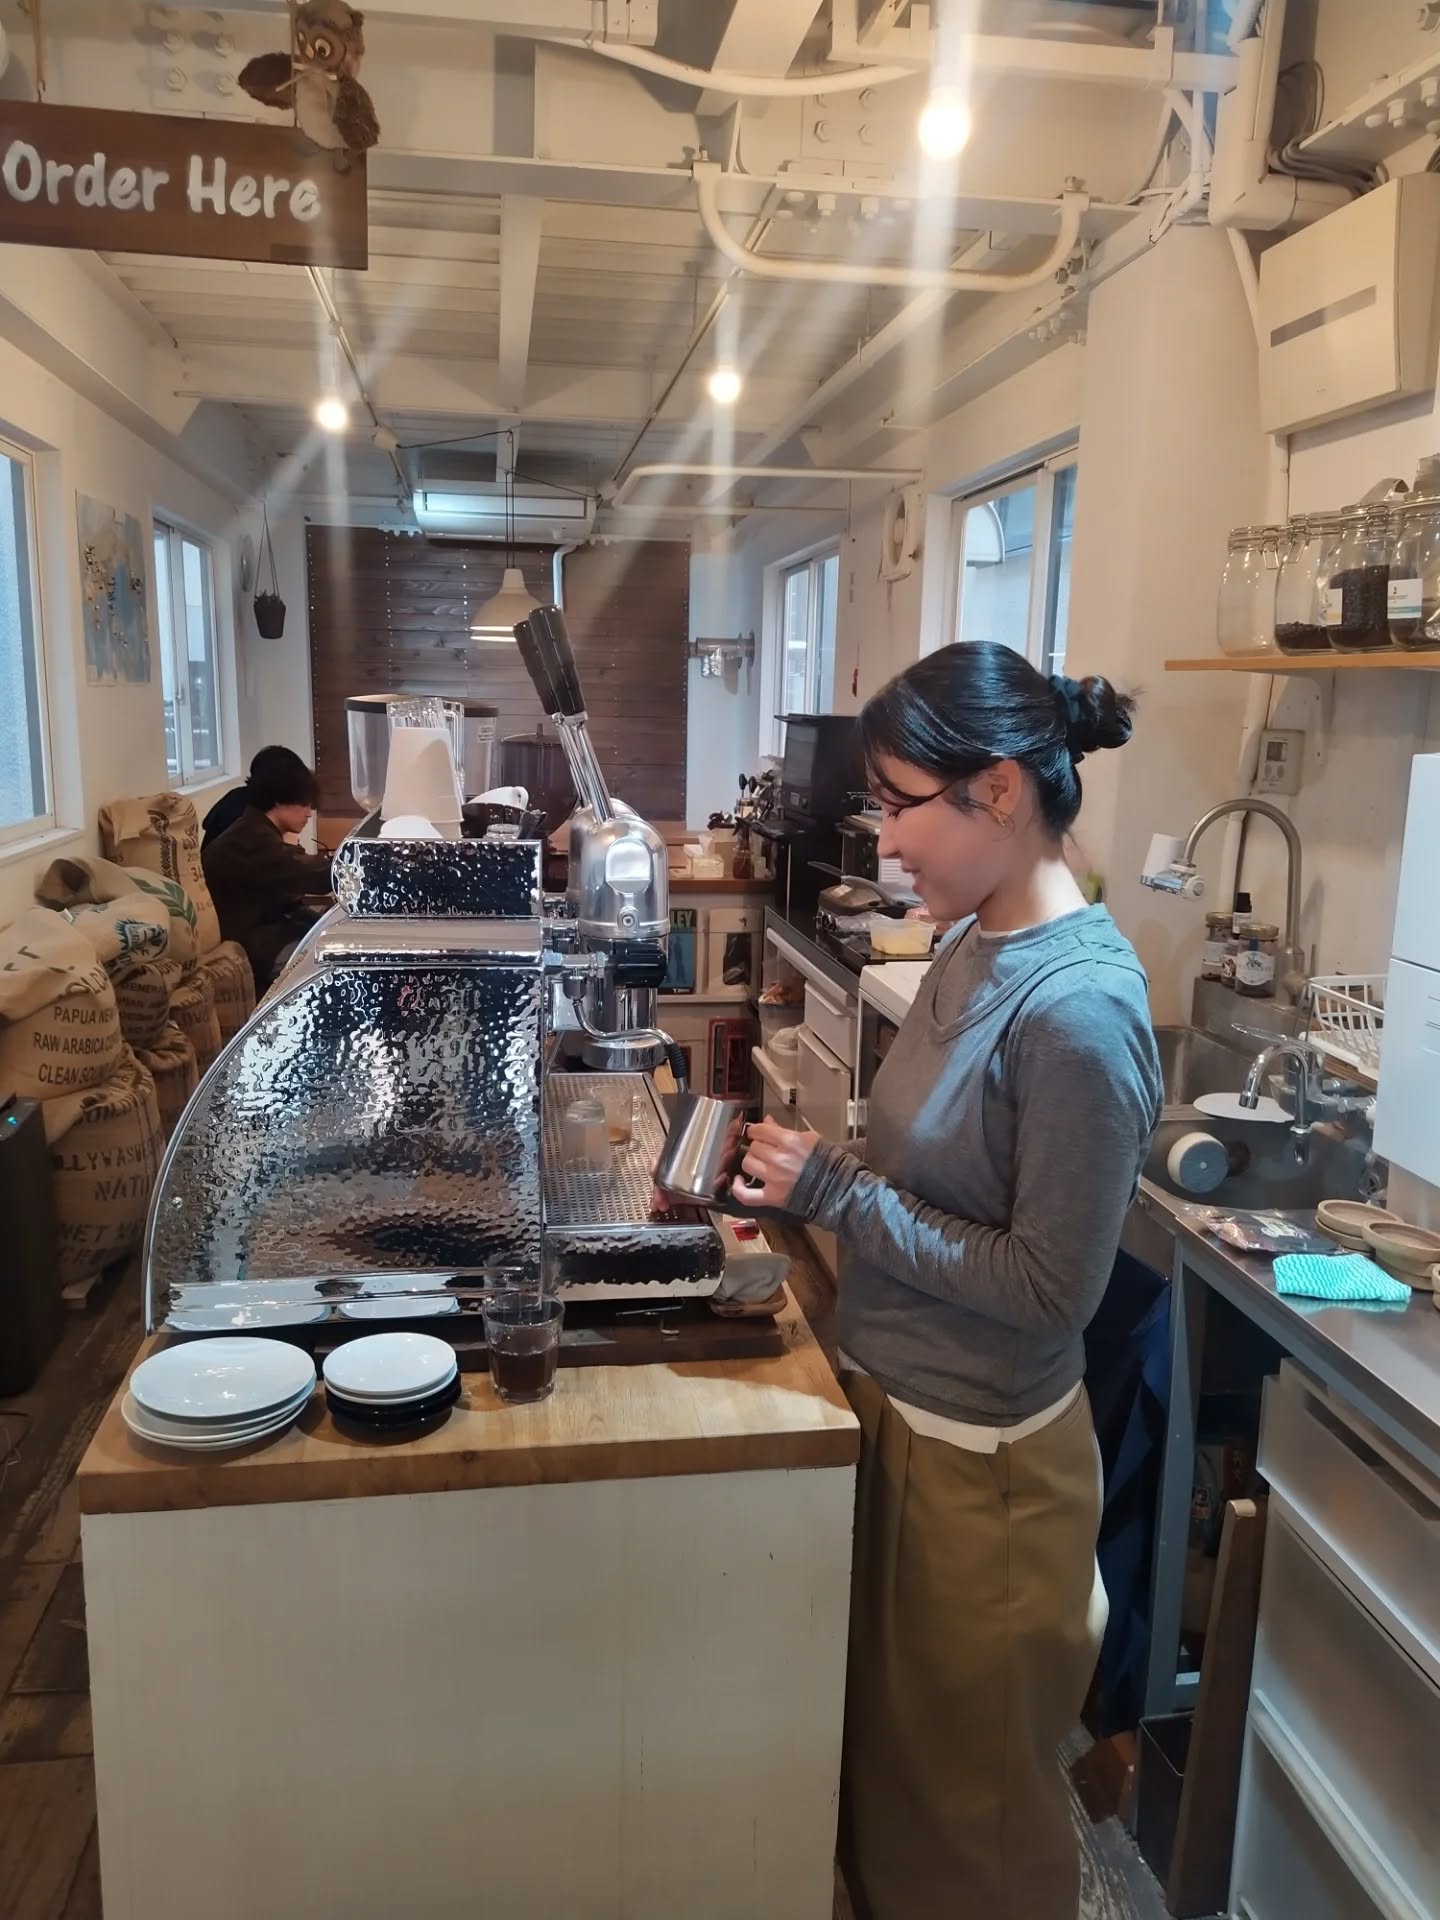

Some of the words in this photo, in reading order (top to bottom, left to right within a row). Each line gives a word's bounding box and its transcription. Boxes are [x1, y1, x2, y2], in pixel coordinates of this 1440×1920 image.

[2, 140, 169, 212] Order
[187, 155, 321, 221] Here
[54, 1006, 96, 1024] PAPUA
[34, 1031, 60, 1052] RAW
[62, 1038, 104, 1055] ARABICA
[38, 1063, 79, 1084] CLEAN
